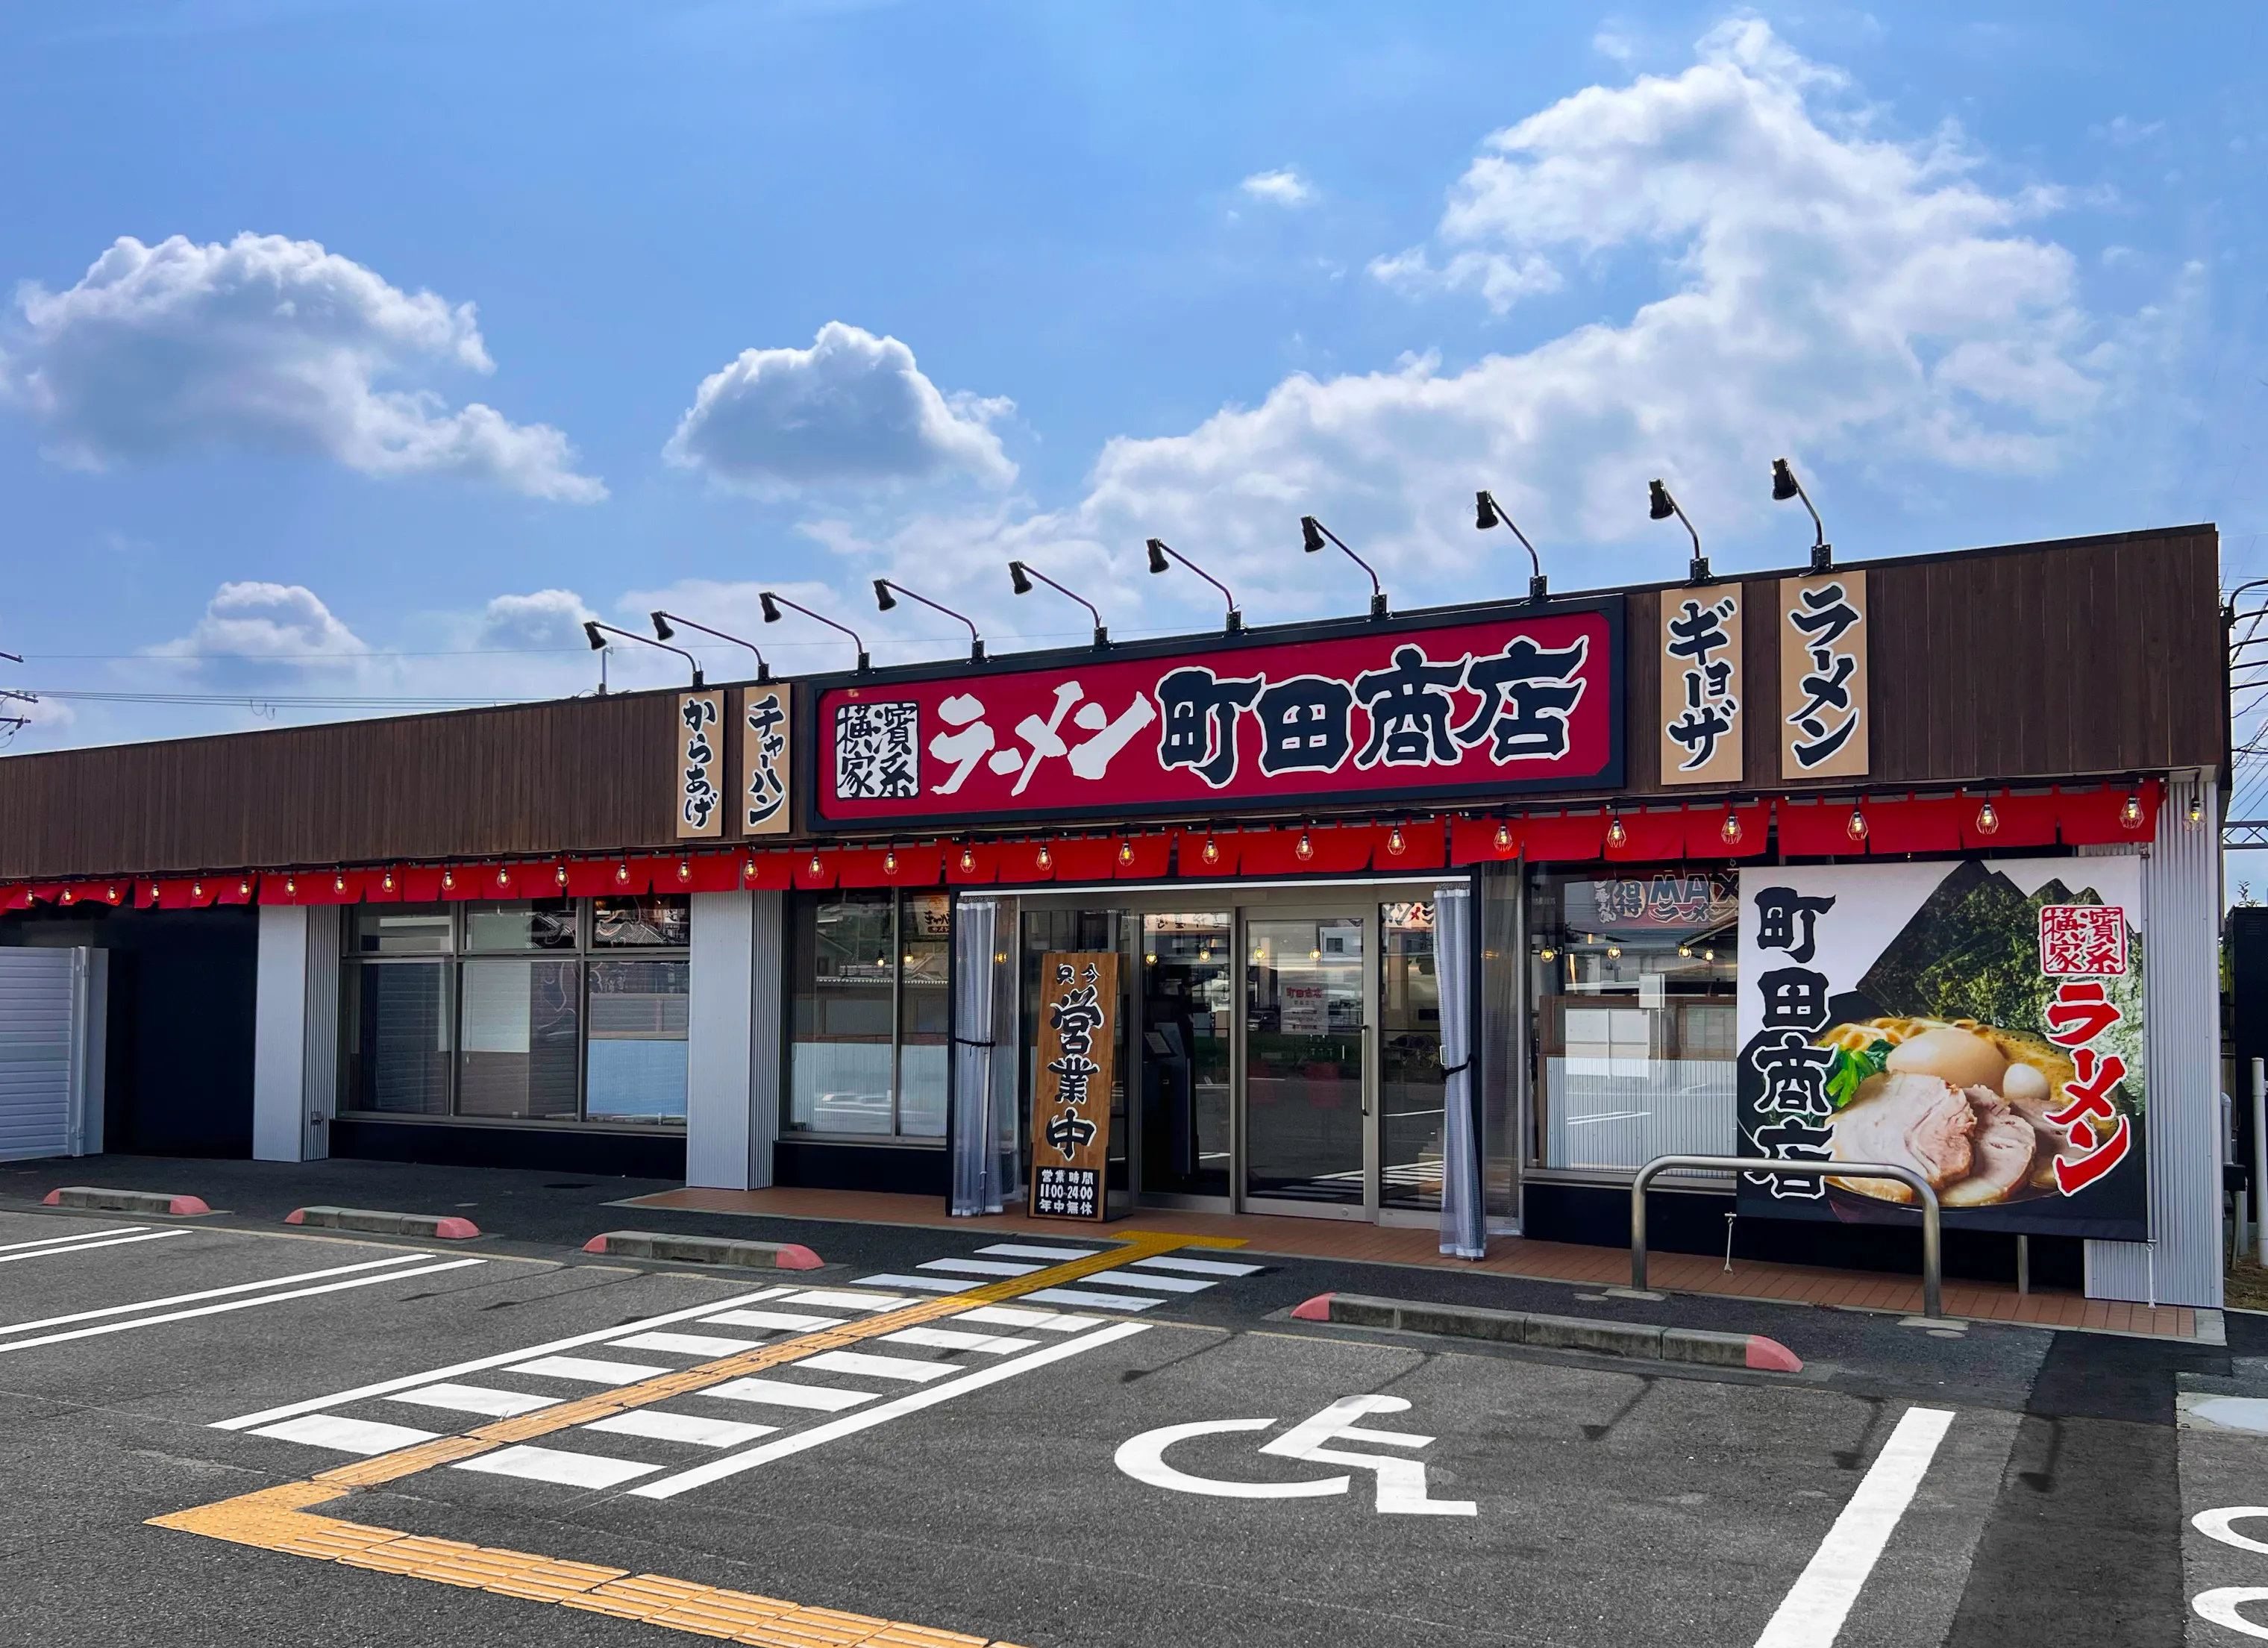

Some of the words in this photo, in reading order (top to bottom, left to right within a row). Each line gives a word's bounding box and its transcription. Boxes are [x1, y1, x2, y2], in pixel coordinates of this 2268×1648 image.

[748, 693, 786, 827] チャーハン
[929, 680, 1158, 797] ラーメン
[1155, 634, 1590, 789] 町田商店
[1665, 595, 1739, 771] ギョーザ
[1786, 581, 1861, 770] ラーメン
[682, 697, 719, 830] からあげ
[1047, 984, 1105, 1162] 営業中
[1744, 886, 1838, 1200] 町田商店
[2044, 981, 2131, 1197] ラーメン
[1039, 1198, 1093, 1215] 年中無休
[1041, 1169, 1093, 1185] 営業時間
